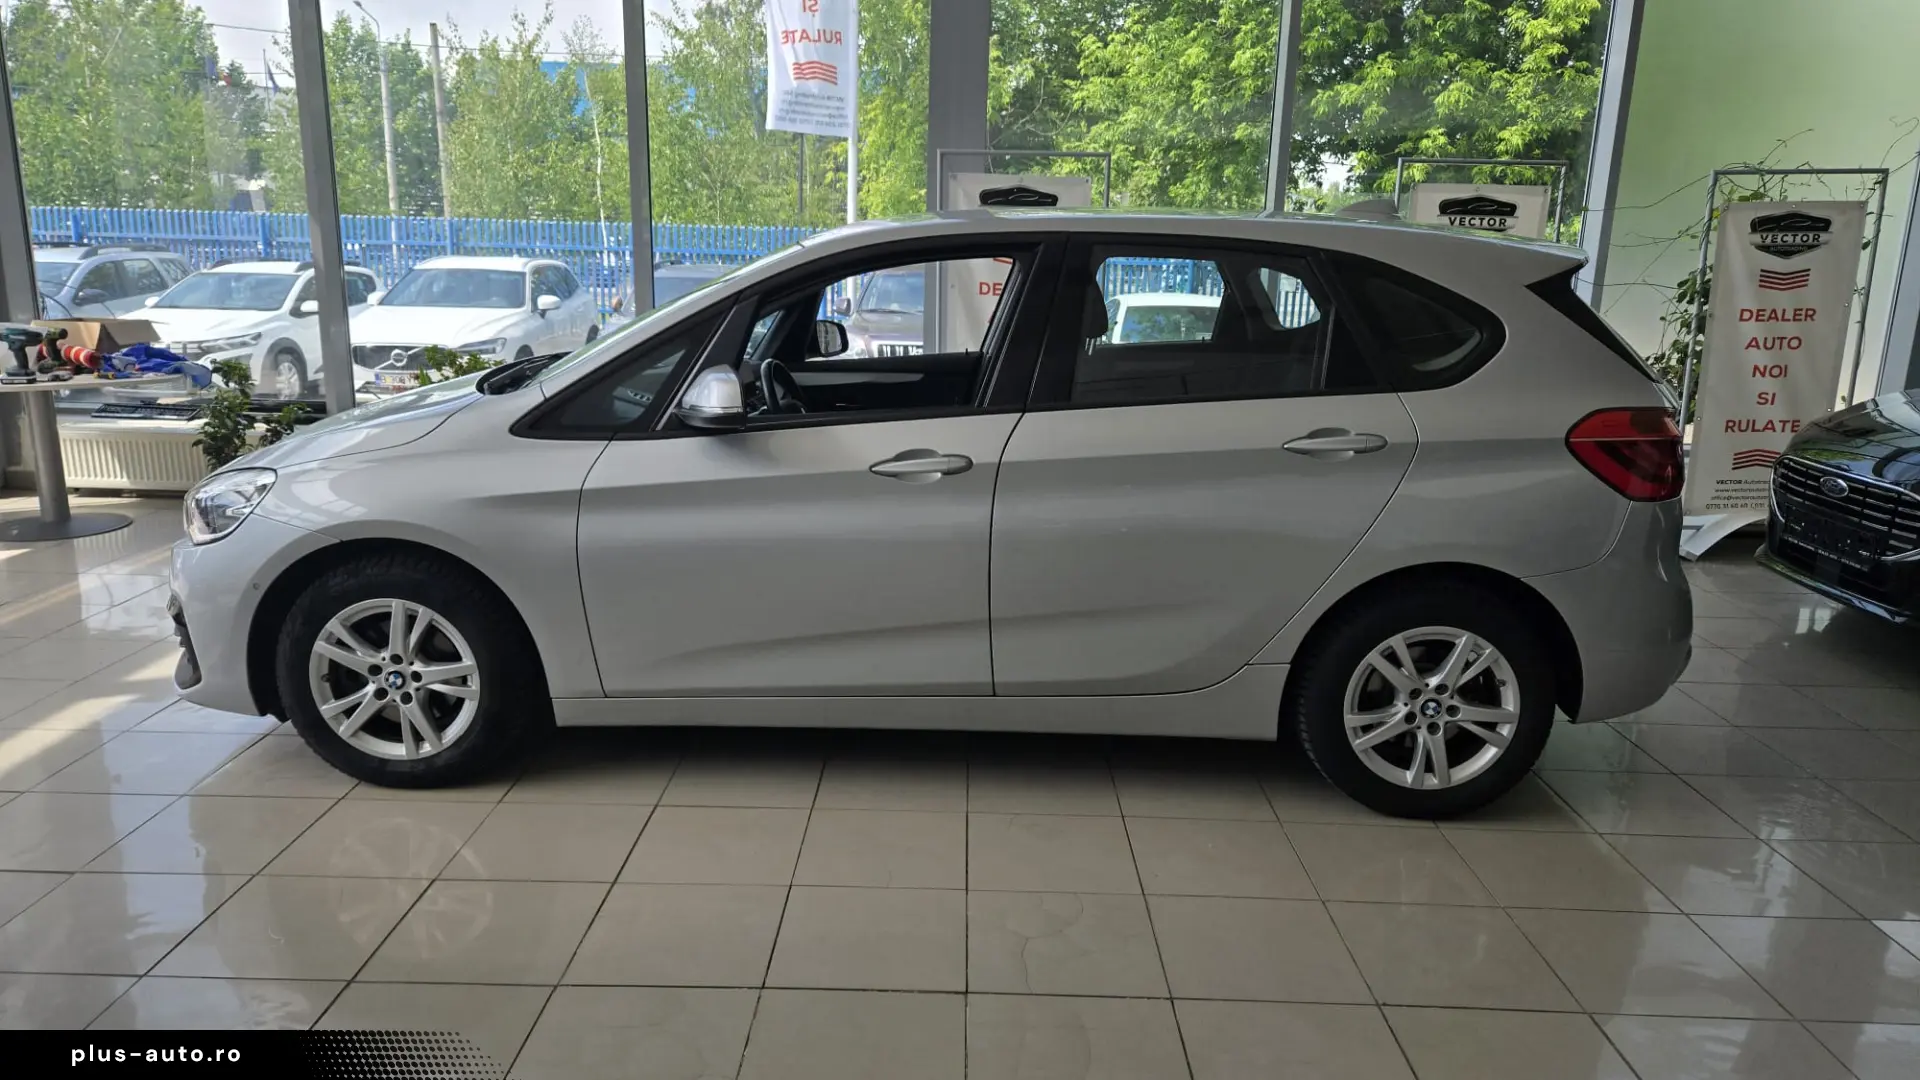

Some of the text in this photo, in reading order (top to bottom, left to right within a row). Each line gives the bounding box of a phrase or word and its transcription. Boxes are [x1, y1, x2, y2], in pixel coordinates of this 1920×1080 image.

[1448, 216, 1507, 228] VECTOR
[1760, 233, 1821, 244] VECTOR
[1738, 308, 1817, 322] DEALER
[1744, 336, 1803, 351] AUTO
[1752, 364, 1788, 378] NOI
[1756, 391, 1777, 406] SI
[1724, 419, 1801, 433] RULATE
